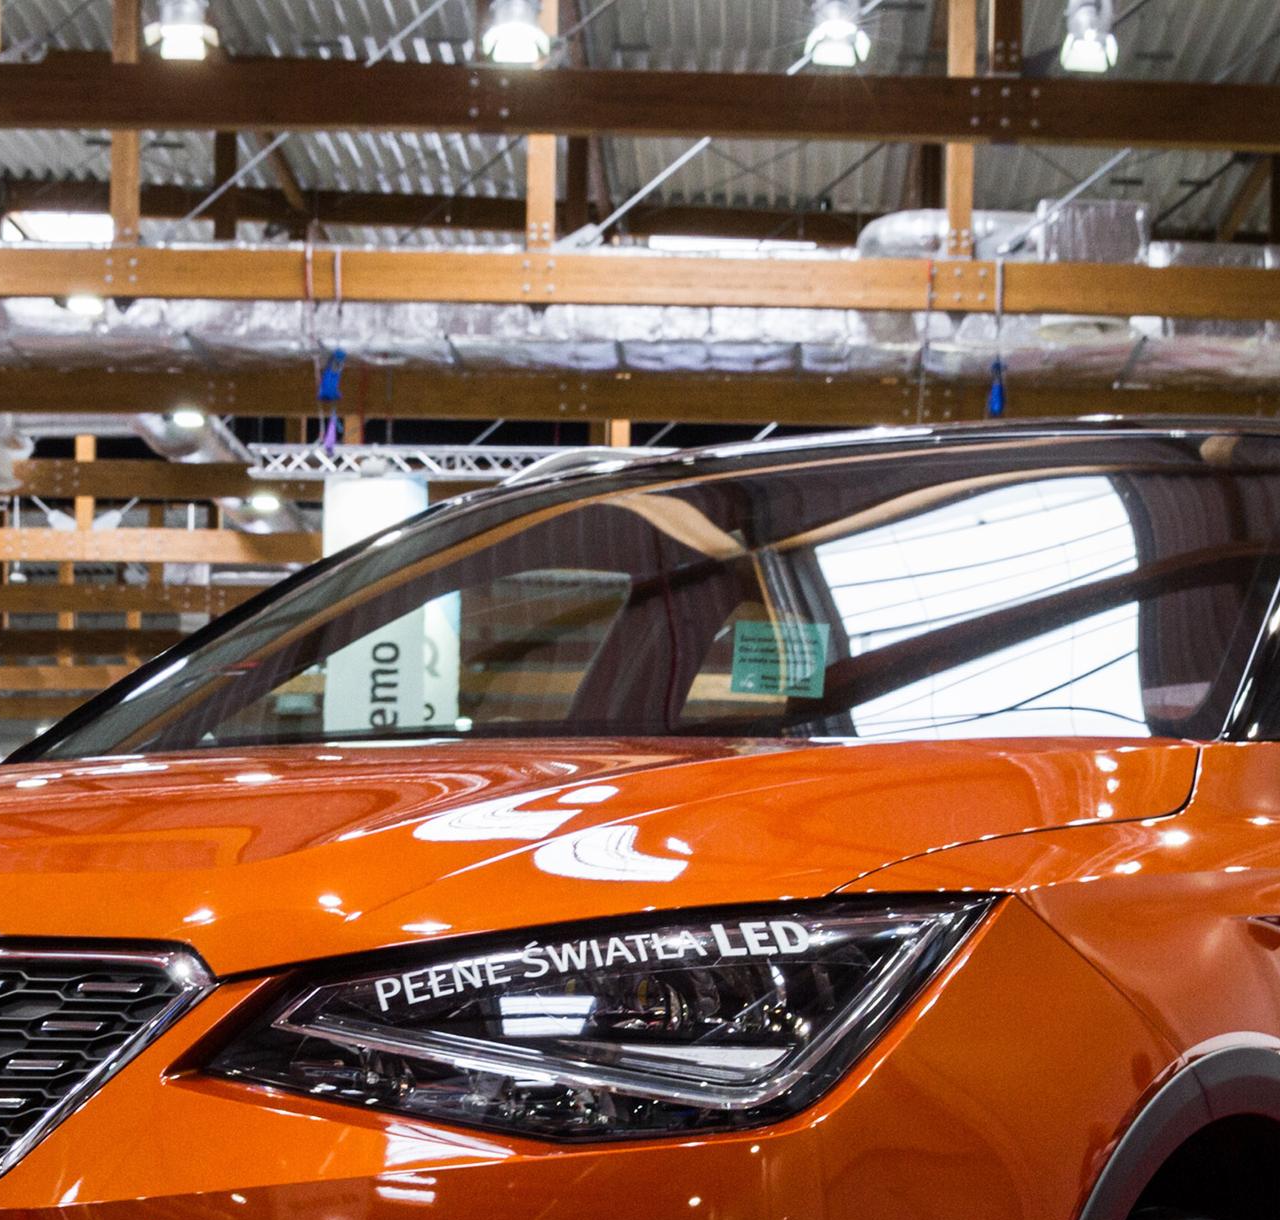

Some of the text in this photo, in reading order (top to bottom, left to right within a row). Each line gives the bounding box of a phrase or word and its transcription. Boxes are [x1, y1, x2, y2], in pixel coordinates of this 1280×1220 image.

[375, 920, 810, 1012] PEŁNE ŚWIATŁA LED
